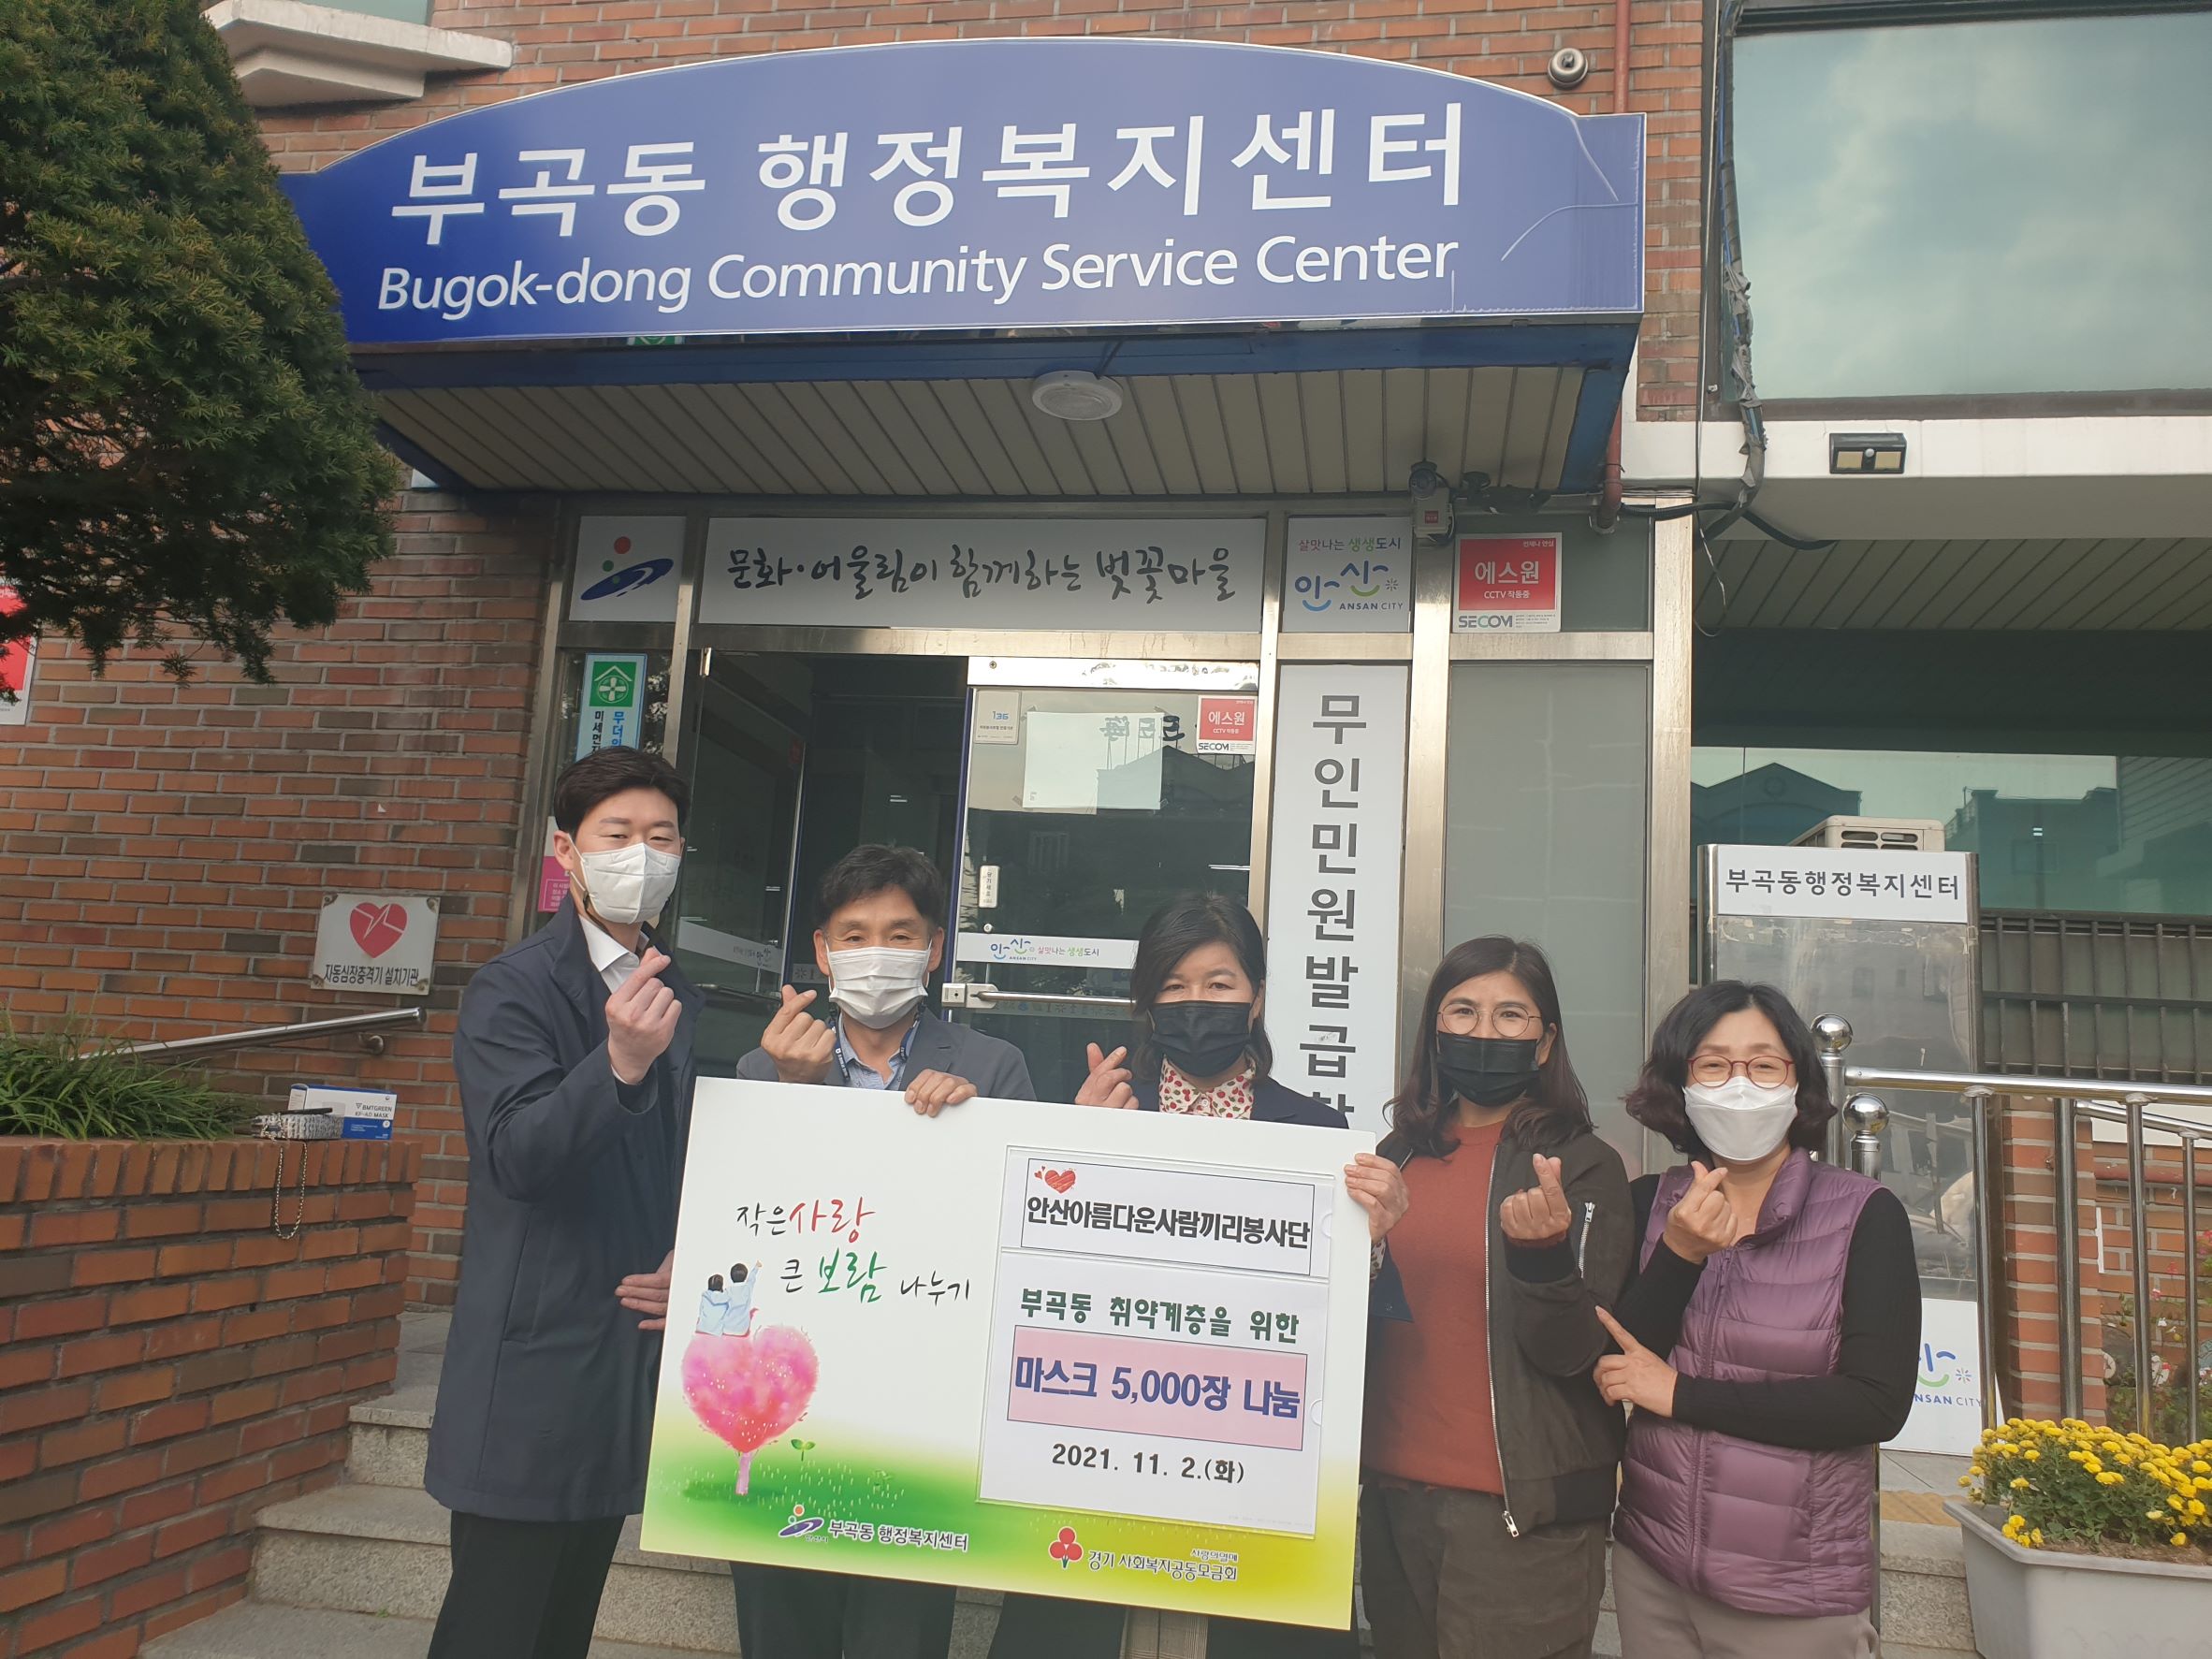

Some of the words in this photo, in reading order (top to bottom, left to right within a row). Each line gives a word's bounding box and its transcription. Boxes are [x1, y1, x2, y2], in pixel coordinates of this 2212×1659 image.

[391, 141, 706, 246] 부곡동
[757, 102, 1462, 231] 행정복지센터
[378, 256, 691, 321] Bugok-dong
[708, 245, 1027, 304] Community
[1041, 238, 1238, 291] Service
[1256, 233, 1459, 284] Center
[1298, 538, 1345, 552] 살맛나는
[1348, 537, 1402, 553] 생생도시
[950, 544, 1082, 600] 함께하는
[1475, 560, 1539, 585] 에스원
[1339, 602, 1378, 611] ANSAN
[1380, 602, 1404, 611] CITY
[1484, 590, 1506, 599] CCTV
[1458, 615, 1513, 629] SECOM
[1208, 710, 1245, 726] 에스원
[1198, 742, 1230, 751] SECOM
[1725, 867, 1959, 900] 부곡동행정복지센터
[1037, 946, 1066, 956] 살맛나는
[324, 963, 384, 984] 자동심장충격기
[385, 967, 420, 988] 설치기관
[1026, 1196, 1311, 1250] 안산아름다운사람끼리봉사단
[779, 1259, 804, 1294] 큰
[818, 1247, 888, 1303] 보람
[899, 1270, 970, 1306] 나누기
[1020, 1288, 1093, 1324] 부곡동
[1109, 1295, 1232, 1338] 취약계층을
[1249, 1310, 1300, 1345] 위한
[1014, 1356, 1099, 1398] 마스크
[1111, 1365, 1232, 1412] 5,000장
[1243, 1378, 1301, 1419] 나눔
[1914, 1392, 1953, 1405] NSAN
[1052, 1443, 1119, 1472] 2021.
[1132, 1450, 1169, 1476] 11.
[1180, 1456, 1245, 1484] 2.(화)
[828, 1519, 874, 1541] 부곡동
[879, 1525, 969, 1551] 행정복지센터
[1088, 1550, 1115, 1572] 경기
[1118, 1552, 1238, 1582] 사회복지공동모금회
[1189, 1548, 1239, 1563] 사랑의열매
